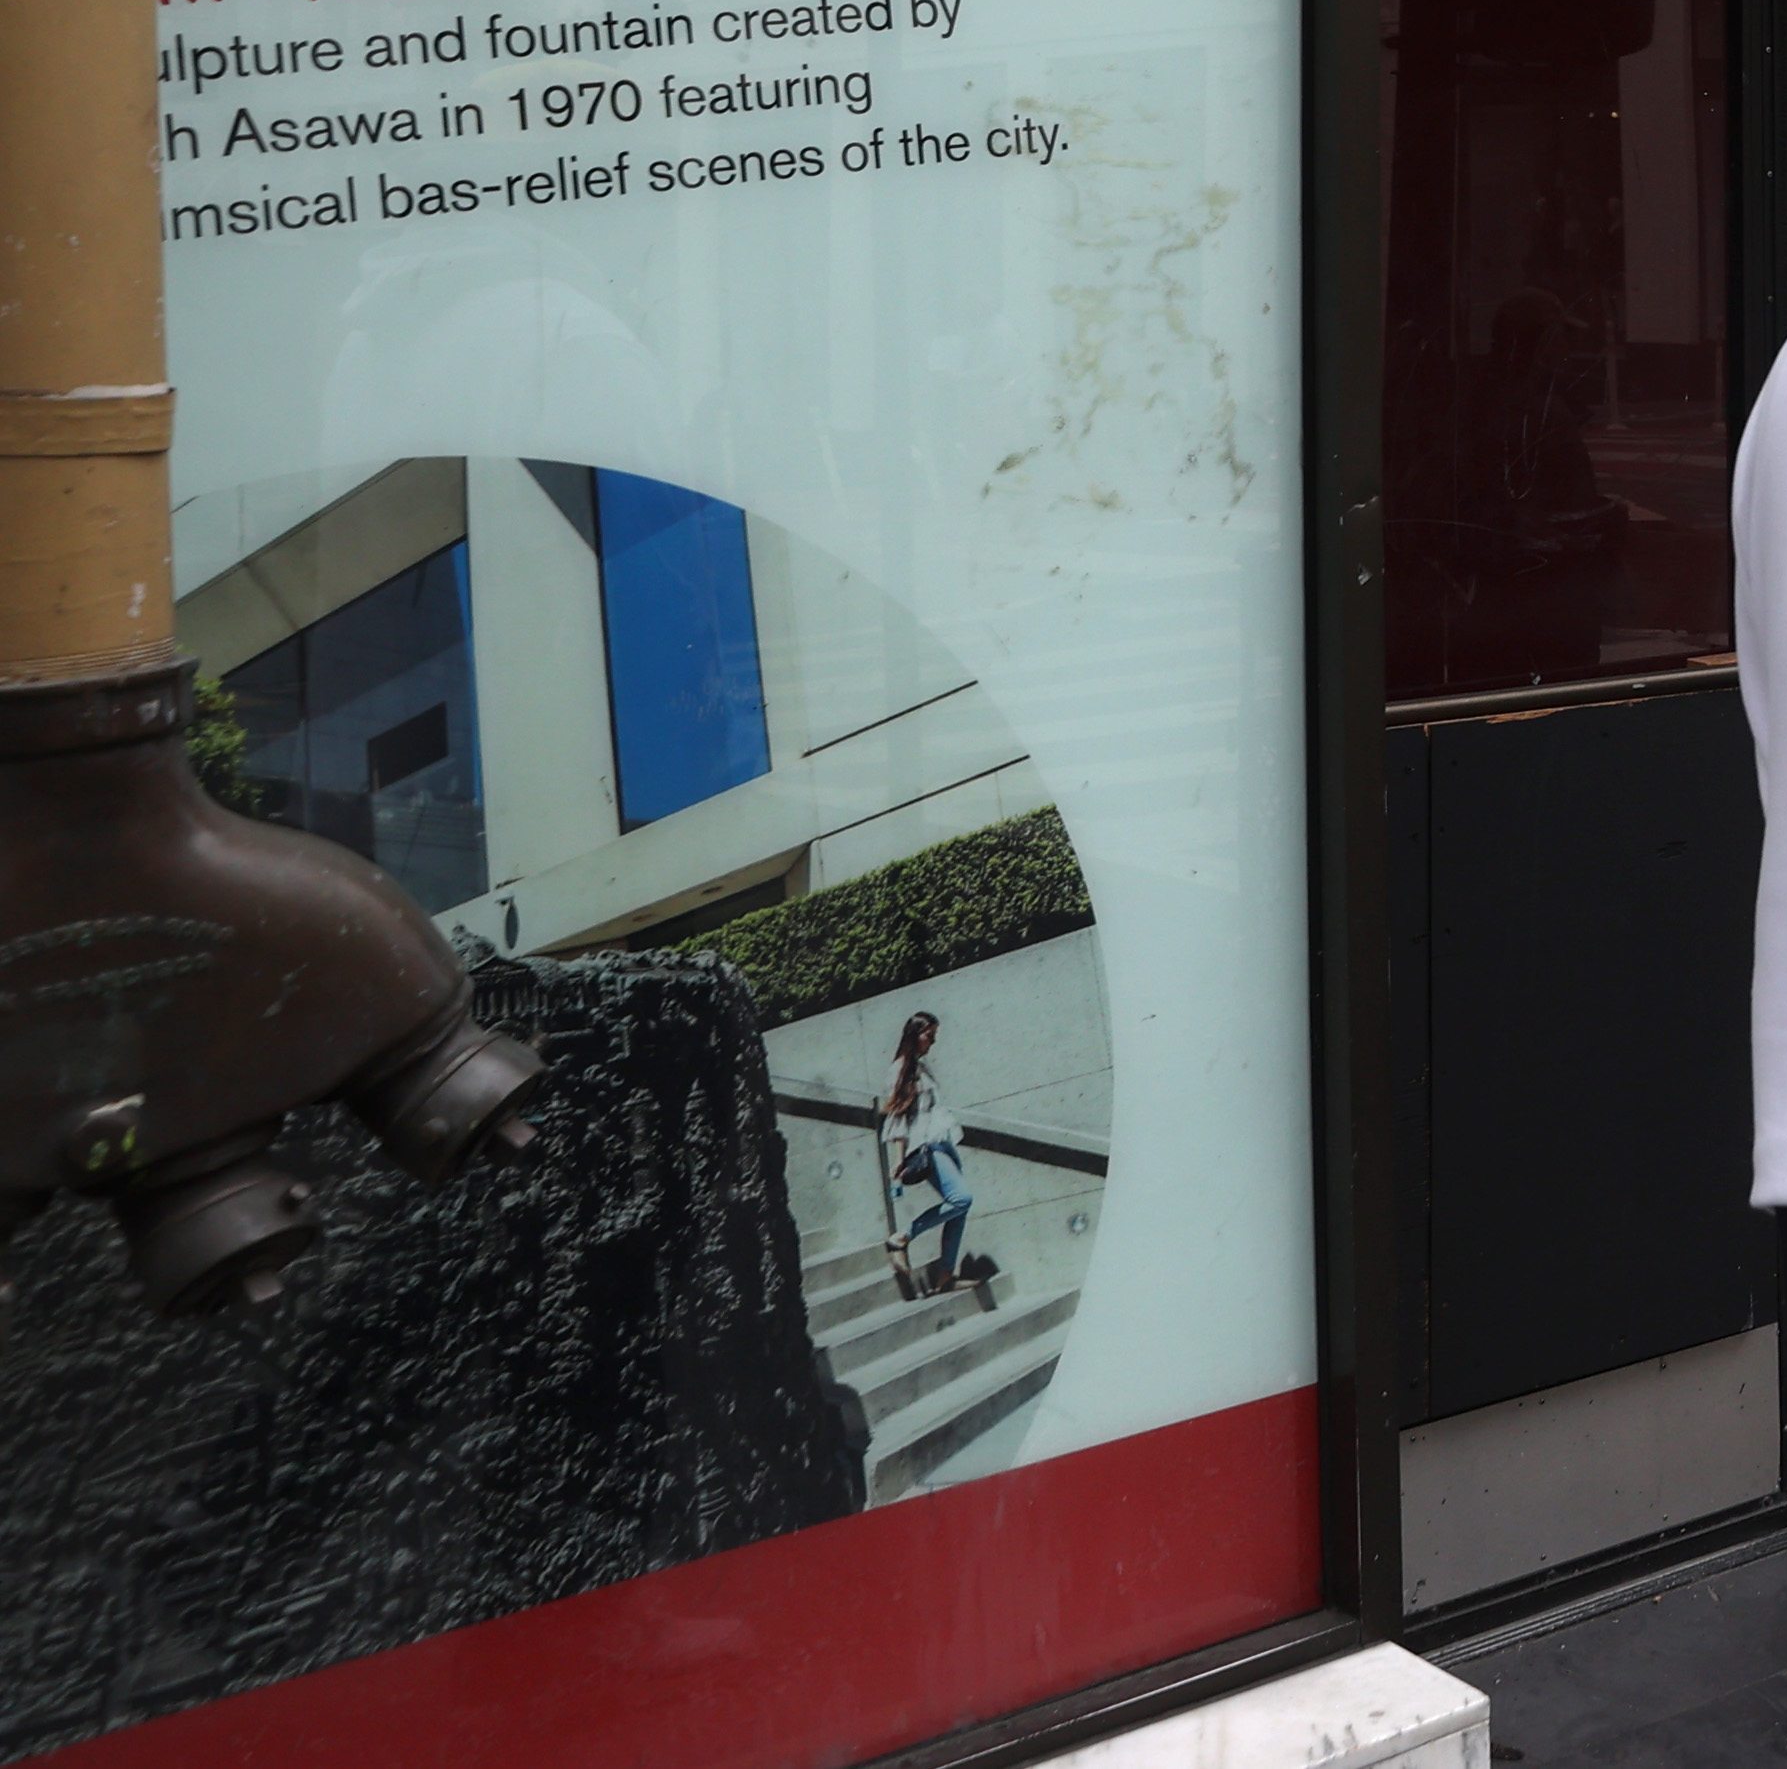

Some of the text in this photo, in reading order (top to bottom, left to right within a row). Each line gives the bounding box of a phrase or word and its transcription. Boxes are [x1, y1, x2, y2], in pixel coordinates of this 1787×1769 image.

[365, 15, 467, 71] and
[484, 2, 695, 60] fountain
[222, 105, 422, 157] Asawa
[441, 90, 484, 138] in
[509, 78, 643, 131] 1970
[659, 63, 874, 125] featuring
[381, 156, 629, 223] bas-relief
[648, 137, 825, 191] scenes
[841, 125, 886, 174] of
[900, 119, 970, 167] the
[986, 112, 1070, 164] city.
